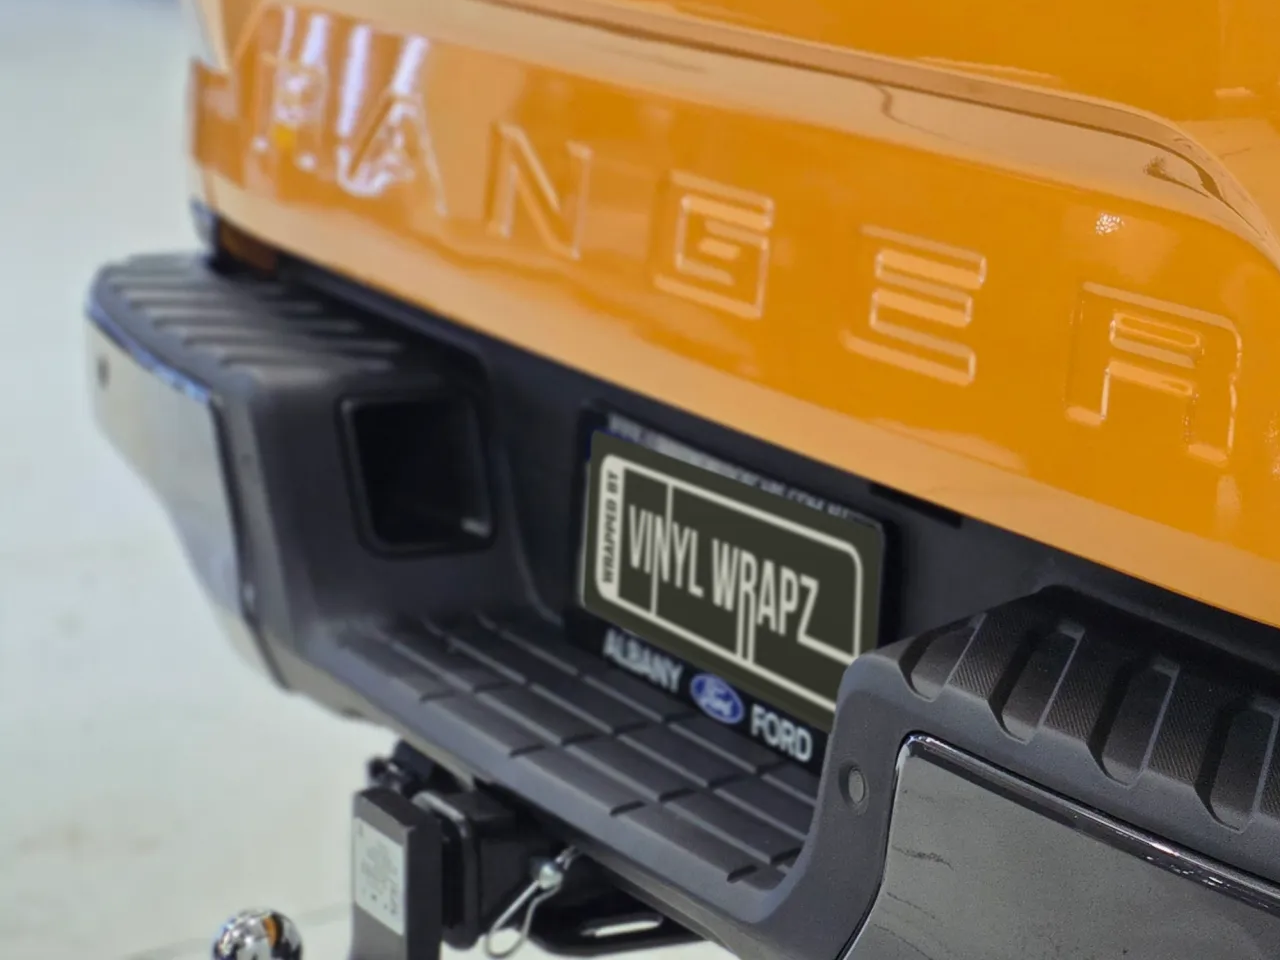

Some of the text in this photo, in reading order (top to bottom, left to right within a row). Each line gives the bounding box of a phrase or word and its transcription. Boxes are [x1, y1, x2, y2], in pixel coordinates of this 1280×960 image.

[602, 468, 620, 584] WRAPPED BY
[628, 499, 822, 648] VINYL WRAPZ
[603, 628, 813, 763] ALBANY FORD
